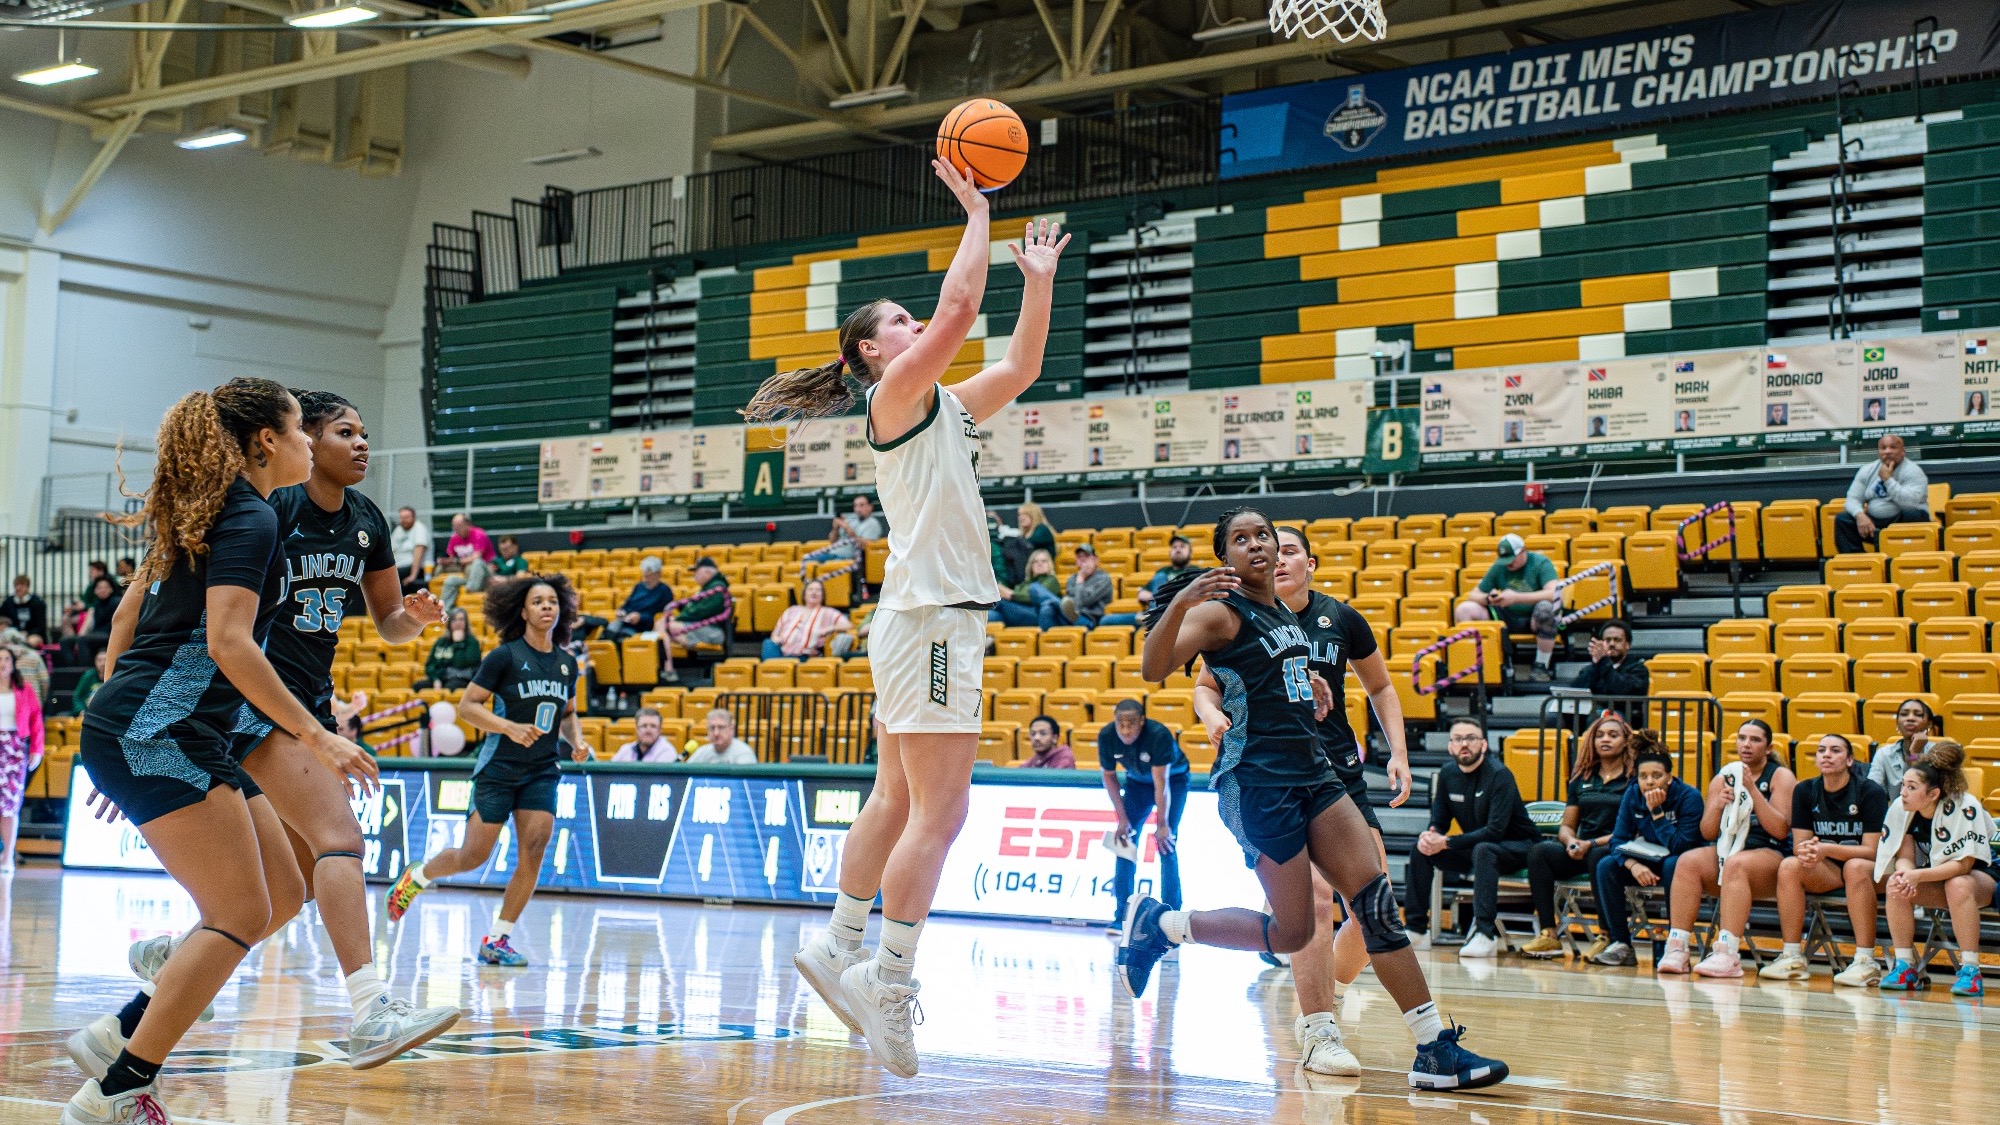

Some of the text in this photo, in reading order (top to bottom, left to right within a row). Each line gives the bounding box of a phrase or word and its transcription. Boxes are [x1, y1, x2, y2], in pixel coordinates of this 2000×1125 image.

[1509, 53, 1571, 92] DII
[1578, 33, 1696, 82] MEN'S
[1403, 28, 1959, 142] BASKETBALL CHAMPIONSHIP
[1767, 372, 1823, 388] RODRIGO
[1863, 367, 1898, 381] JOAO
[1588, 386, 1623, 400] KHIBA
[1675, 380, 1709, 394] MARK
[1425, 399, 1451, 411] LIAM
[1505, 393, 1533, 406] ZYON
[1224, 411, 1284, 424] ALEXANDER
[1295, 406, 1339, 420] JULIANO
[1382, 421, 1403, 461] B
[753, 461, 773, 496] A
[293, 587, 348, 633] 35
[933, 644, 946, 703] MINERS
[1282, 656, 1313, 703] 15
[534, 701, 558, 734] 0
[1813, 821, 1863, 836] LINCOLN
[995, 871, 1063, 894] 104.9
[1091, 876, 1153, 897] 140
